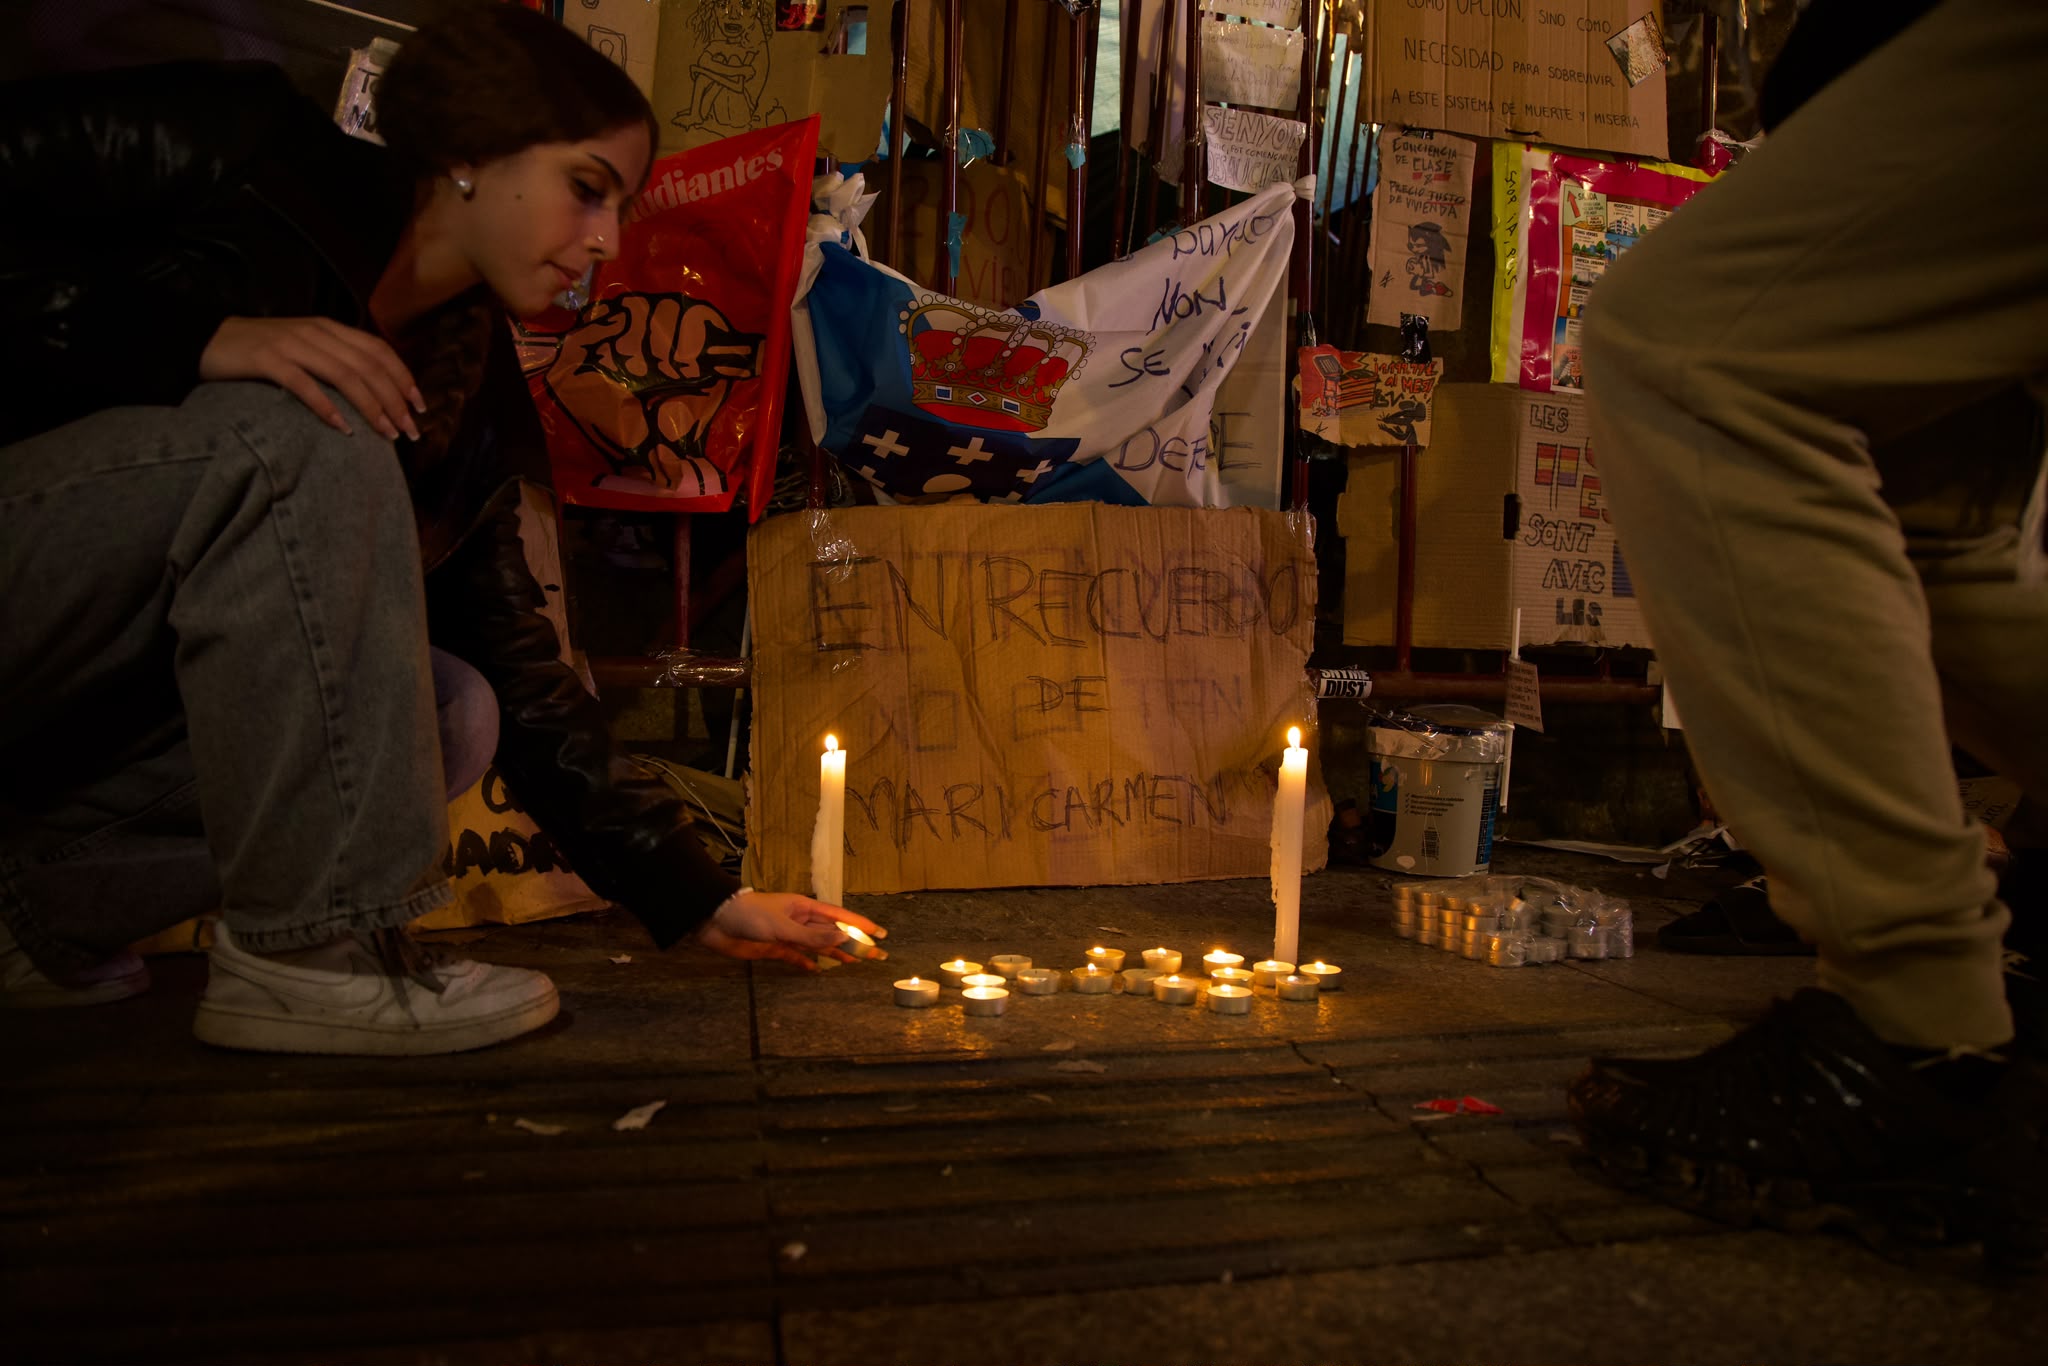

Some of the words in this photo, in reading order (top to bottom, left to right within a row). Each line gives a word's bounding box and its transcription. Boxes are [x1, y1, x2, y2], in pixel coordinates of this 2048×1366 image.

[1538, 10, 1566, 27] SINO
[1576, 17, 1612, 34] COMO
[1404, 37, 1504, 73] NECESIDAD
[1512, 61, 1540, 75] PARA
[1548, 66, 1615, 88] SOBREVIVIR
[1391, 88, 1401, 104] A
[1408, 90, 1439, 108] ESTE
[1446, 94, 1495, 113] SISTEMA
[1501, 102, 1516, 116] DE
[1525, 104, 1573, 121] MUERTE
[1594, 112, 1640, 129] MISERIA
[1393, 137, 1457, 160] CONCIENCIA
[1395, 154, 1409, 165] DE
[1412, 157, 1454, 174] CLASE
[1389, 180, 1425, 197] PRECIO
[1428, 191, 1465, 205] JUSTO
[1389, 194, 1404, 206] DE
[1406, 199, 1458, 219] VIVIENDA
[1146, 276, 1227, 336] NON
[1108, 347, 1170, 388] SE
[1530, 404, 1569, 433] LES
[1525, 513, 1595, 553] SONT
[1543, 559, 1606, 594] AVEC
[805, 554, 948, 656] EN
[980, 553, 1300, 648] RECUERDO
[1026, 674, 1109, 713] DE
[1323, 680, 1367, 697] DUST
[845, 774, 1013, 858] MARI
[1029, 770, 1232, 834] CARMEN
